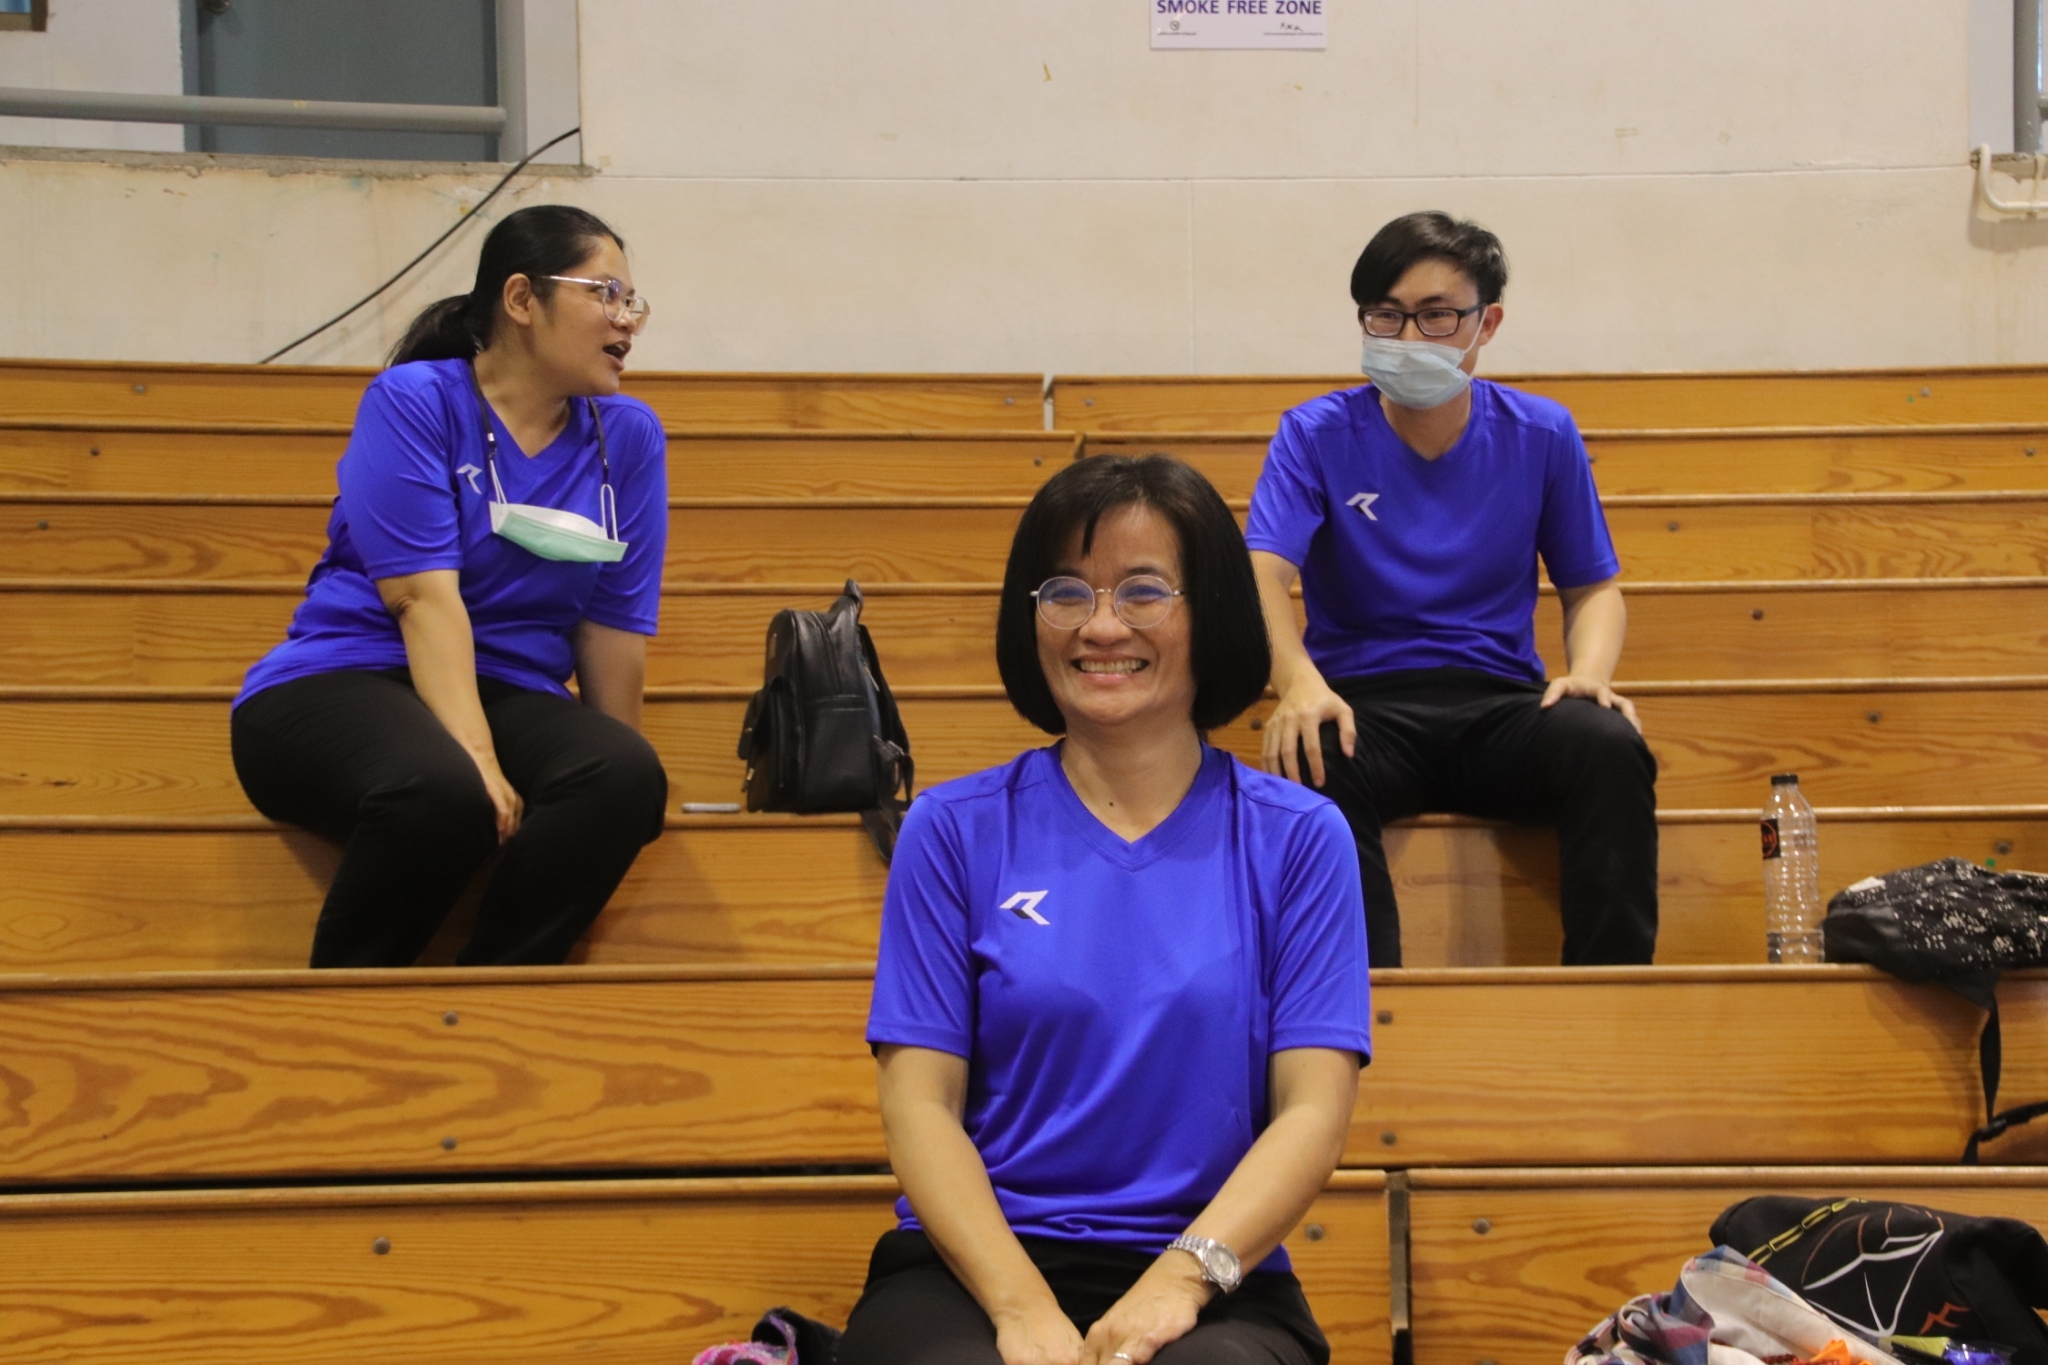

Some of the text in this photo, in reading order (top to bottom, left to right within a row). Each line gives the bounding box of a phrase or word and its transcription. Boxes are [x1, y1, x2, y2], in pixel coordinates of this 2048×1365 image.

[1157, 0, 1322, 14] SMOKE FREE ZONE
